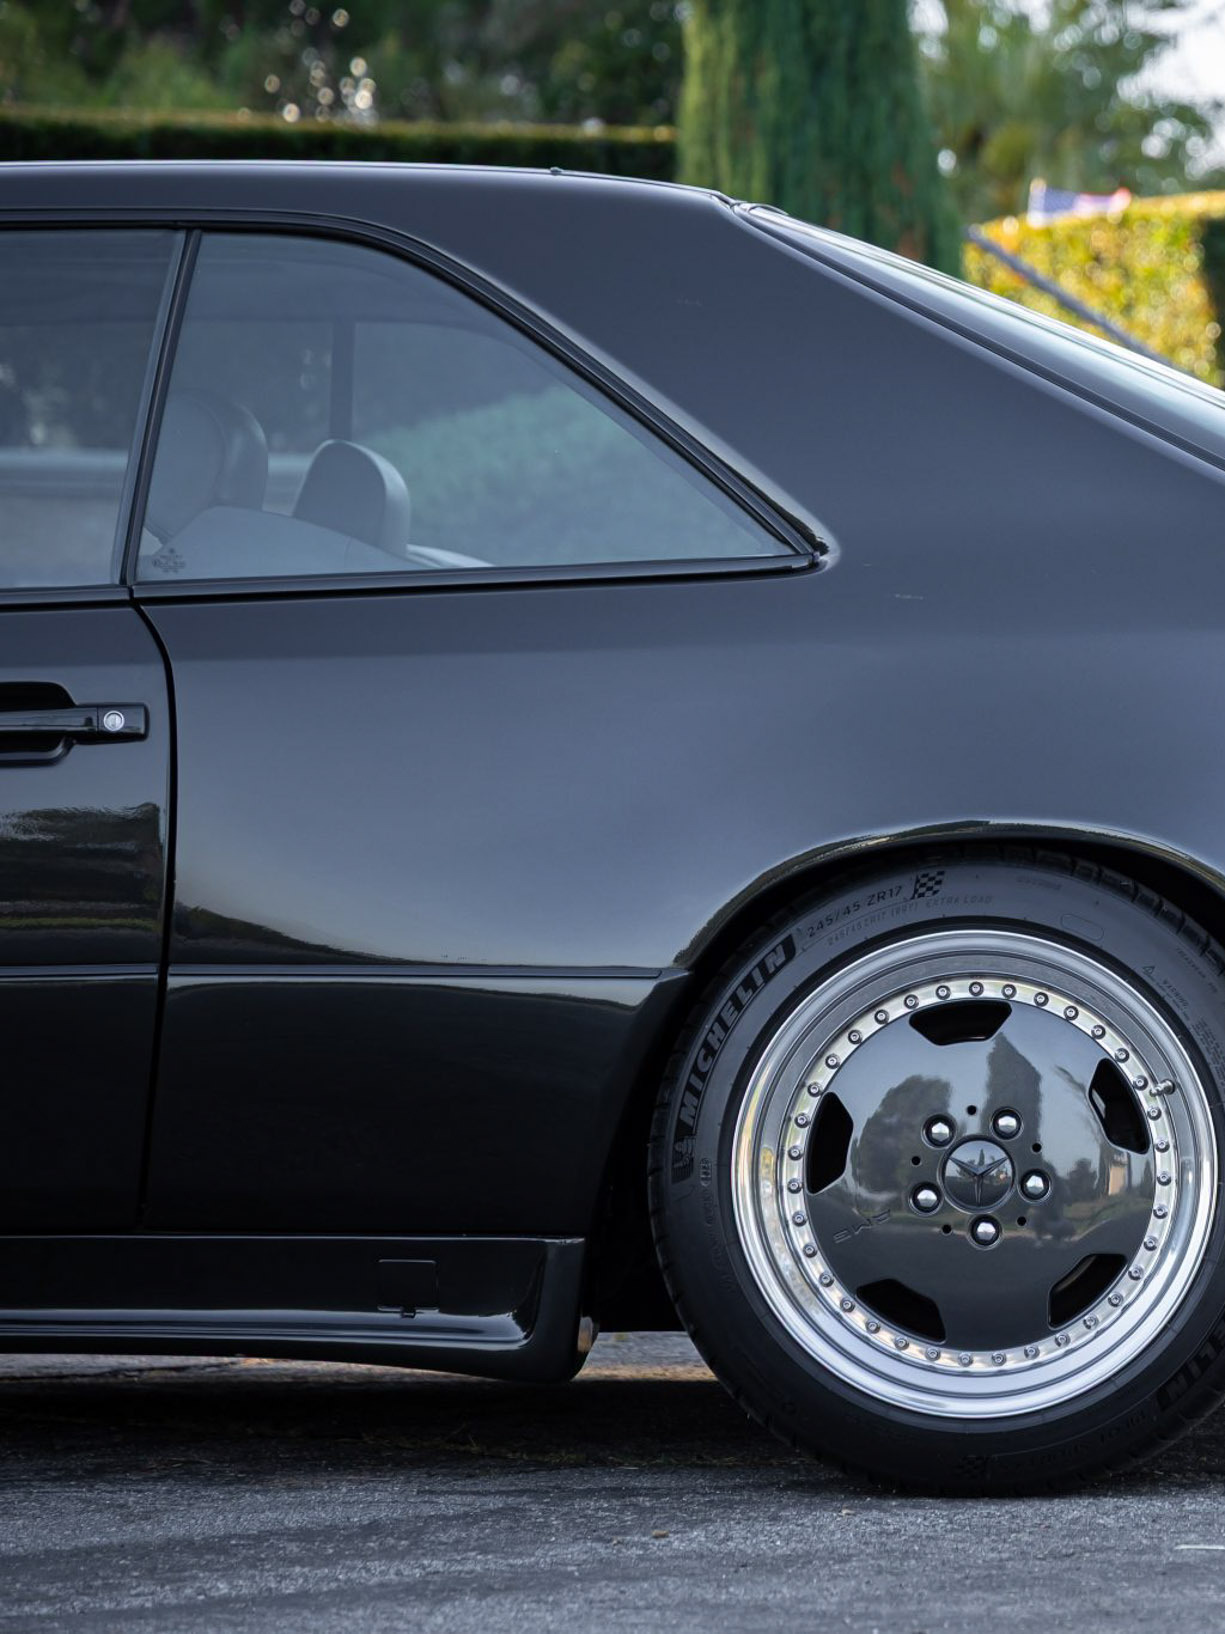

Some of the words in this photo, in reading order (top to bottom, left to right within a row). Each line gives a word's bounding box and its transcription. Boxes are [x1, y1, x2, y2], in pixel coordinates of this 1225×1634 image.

[807, 901, 861, 938] 245/45
[866, 885, 903, 907] ZR17
[963, 894, 991, 904] LOAD
[678, 942, 789, 1126] MICHELIN
